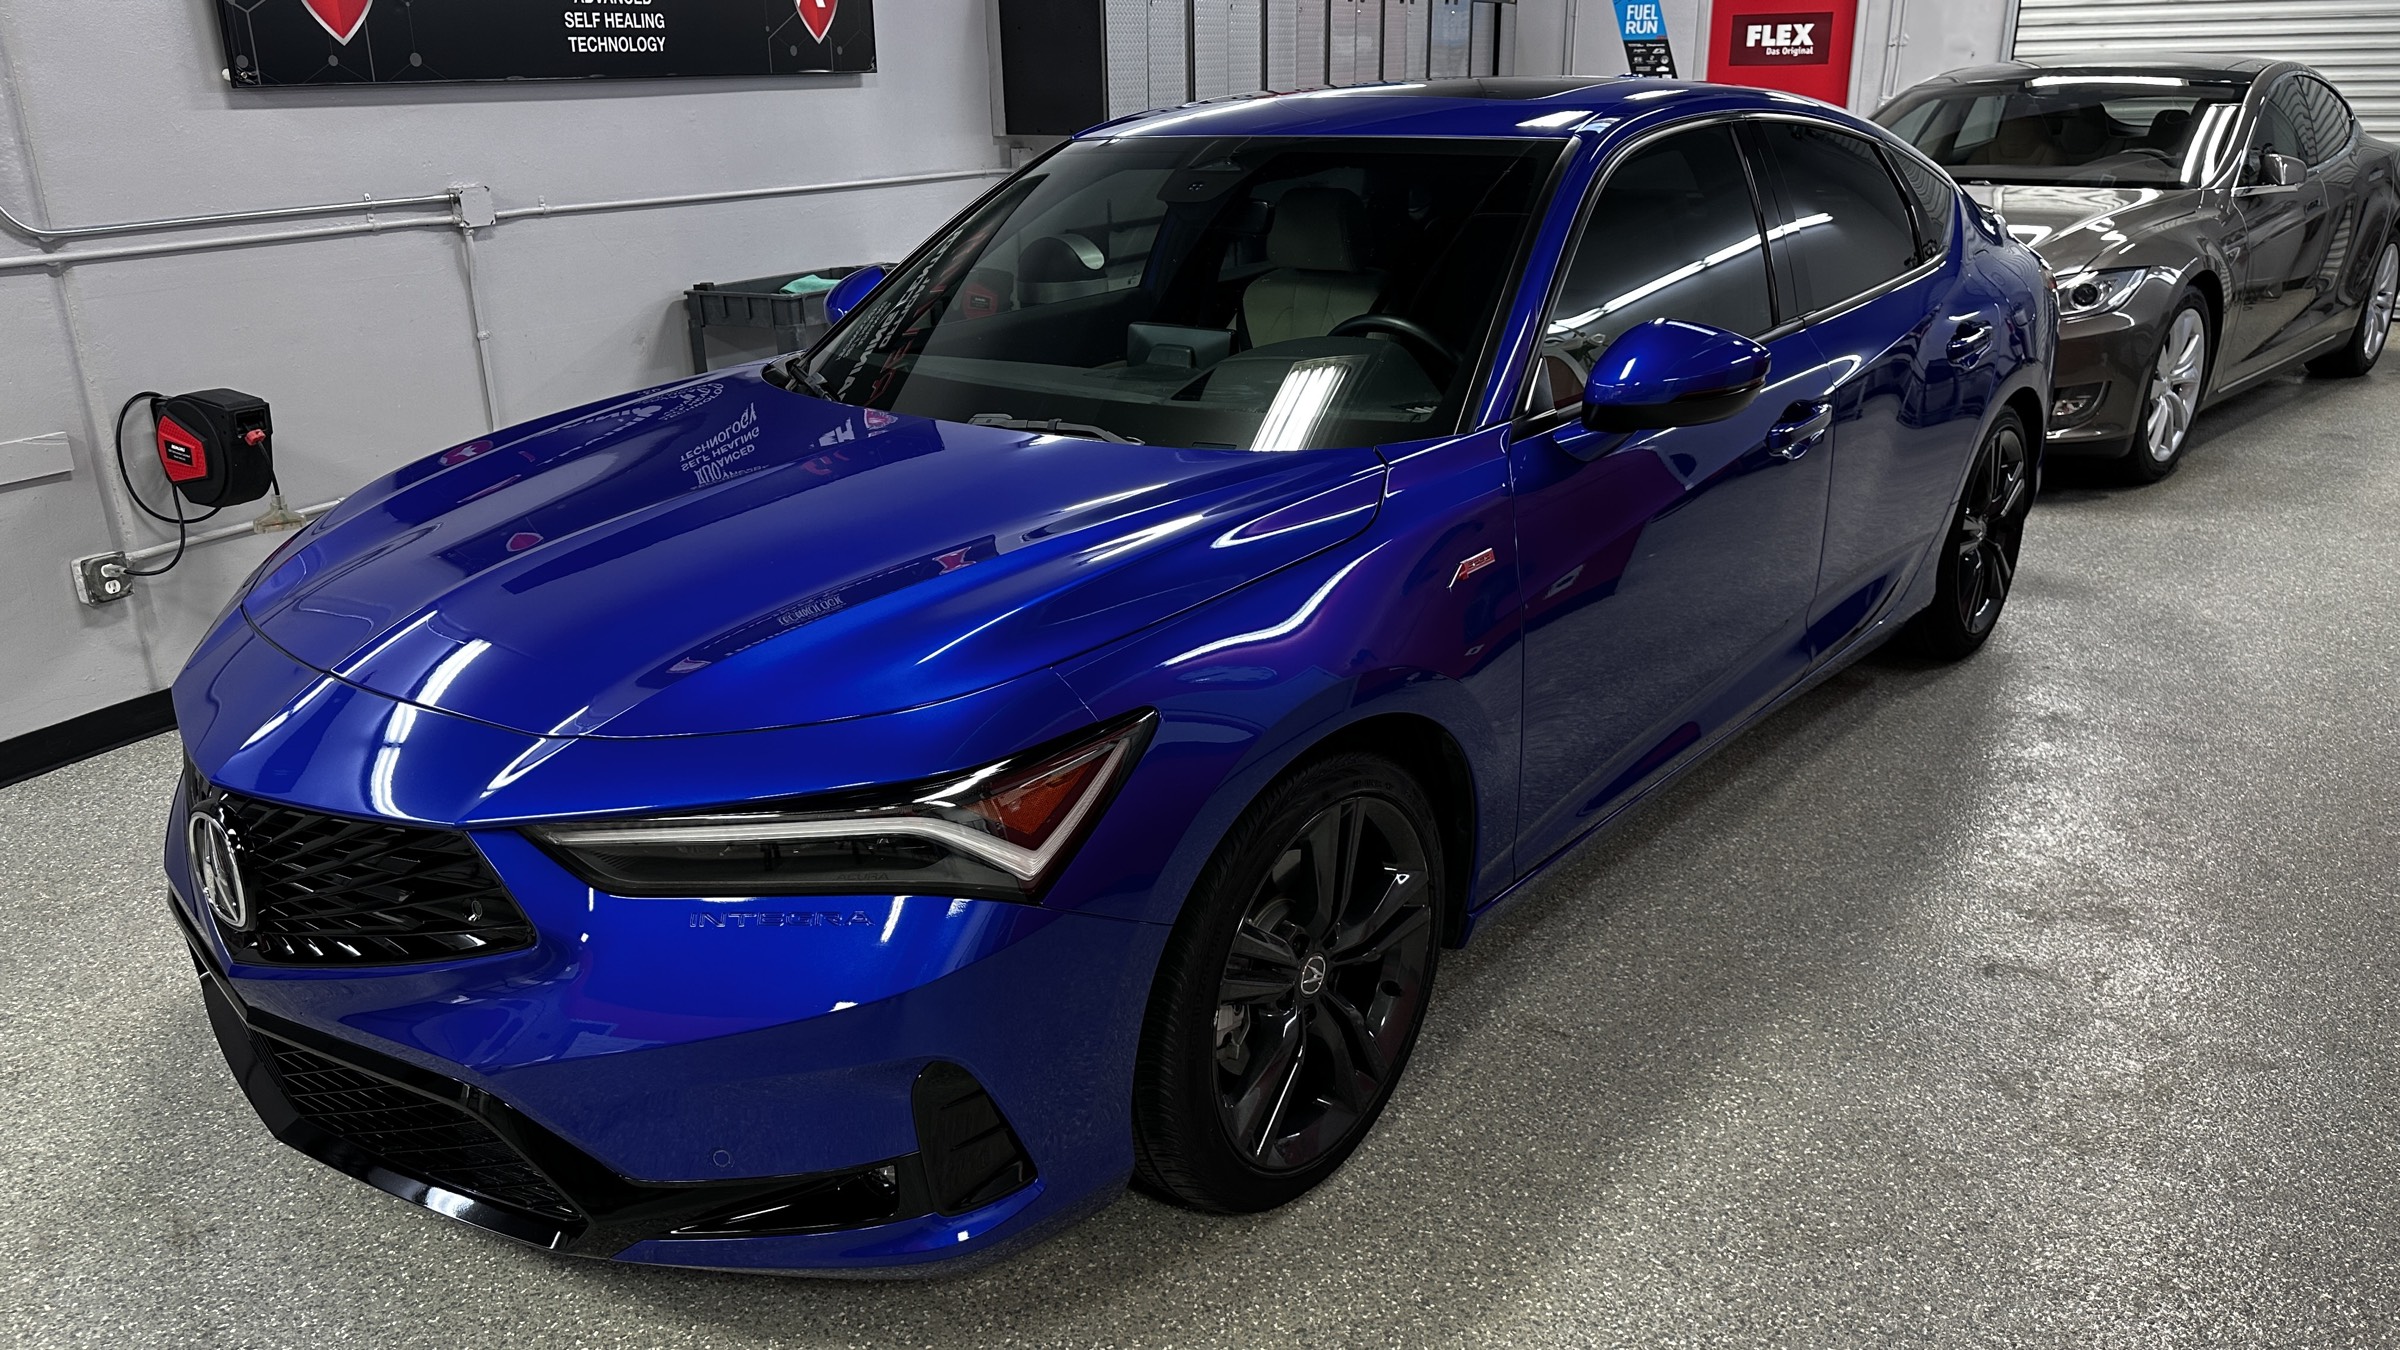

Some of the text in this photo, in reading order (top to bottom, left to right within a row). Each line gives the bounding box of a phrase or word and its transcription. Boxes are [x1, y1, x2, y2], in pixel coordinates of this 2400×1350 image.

[1626, 4, 1659, 20] FUEL
[564, 12, 665, 29] SELF HEALING
[1625, 20, 1658, 35] RUN
[1746, 23, 1815, 47] FLEX
[567, 36, 666, 52] TECHNOLOGY
[1766, 46, 1814, 57] Das Original
[689, 910, 876, 928] INTEGRA
